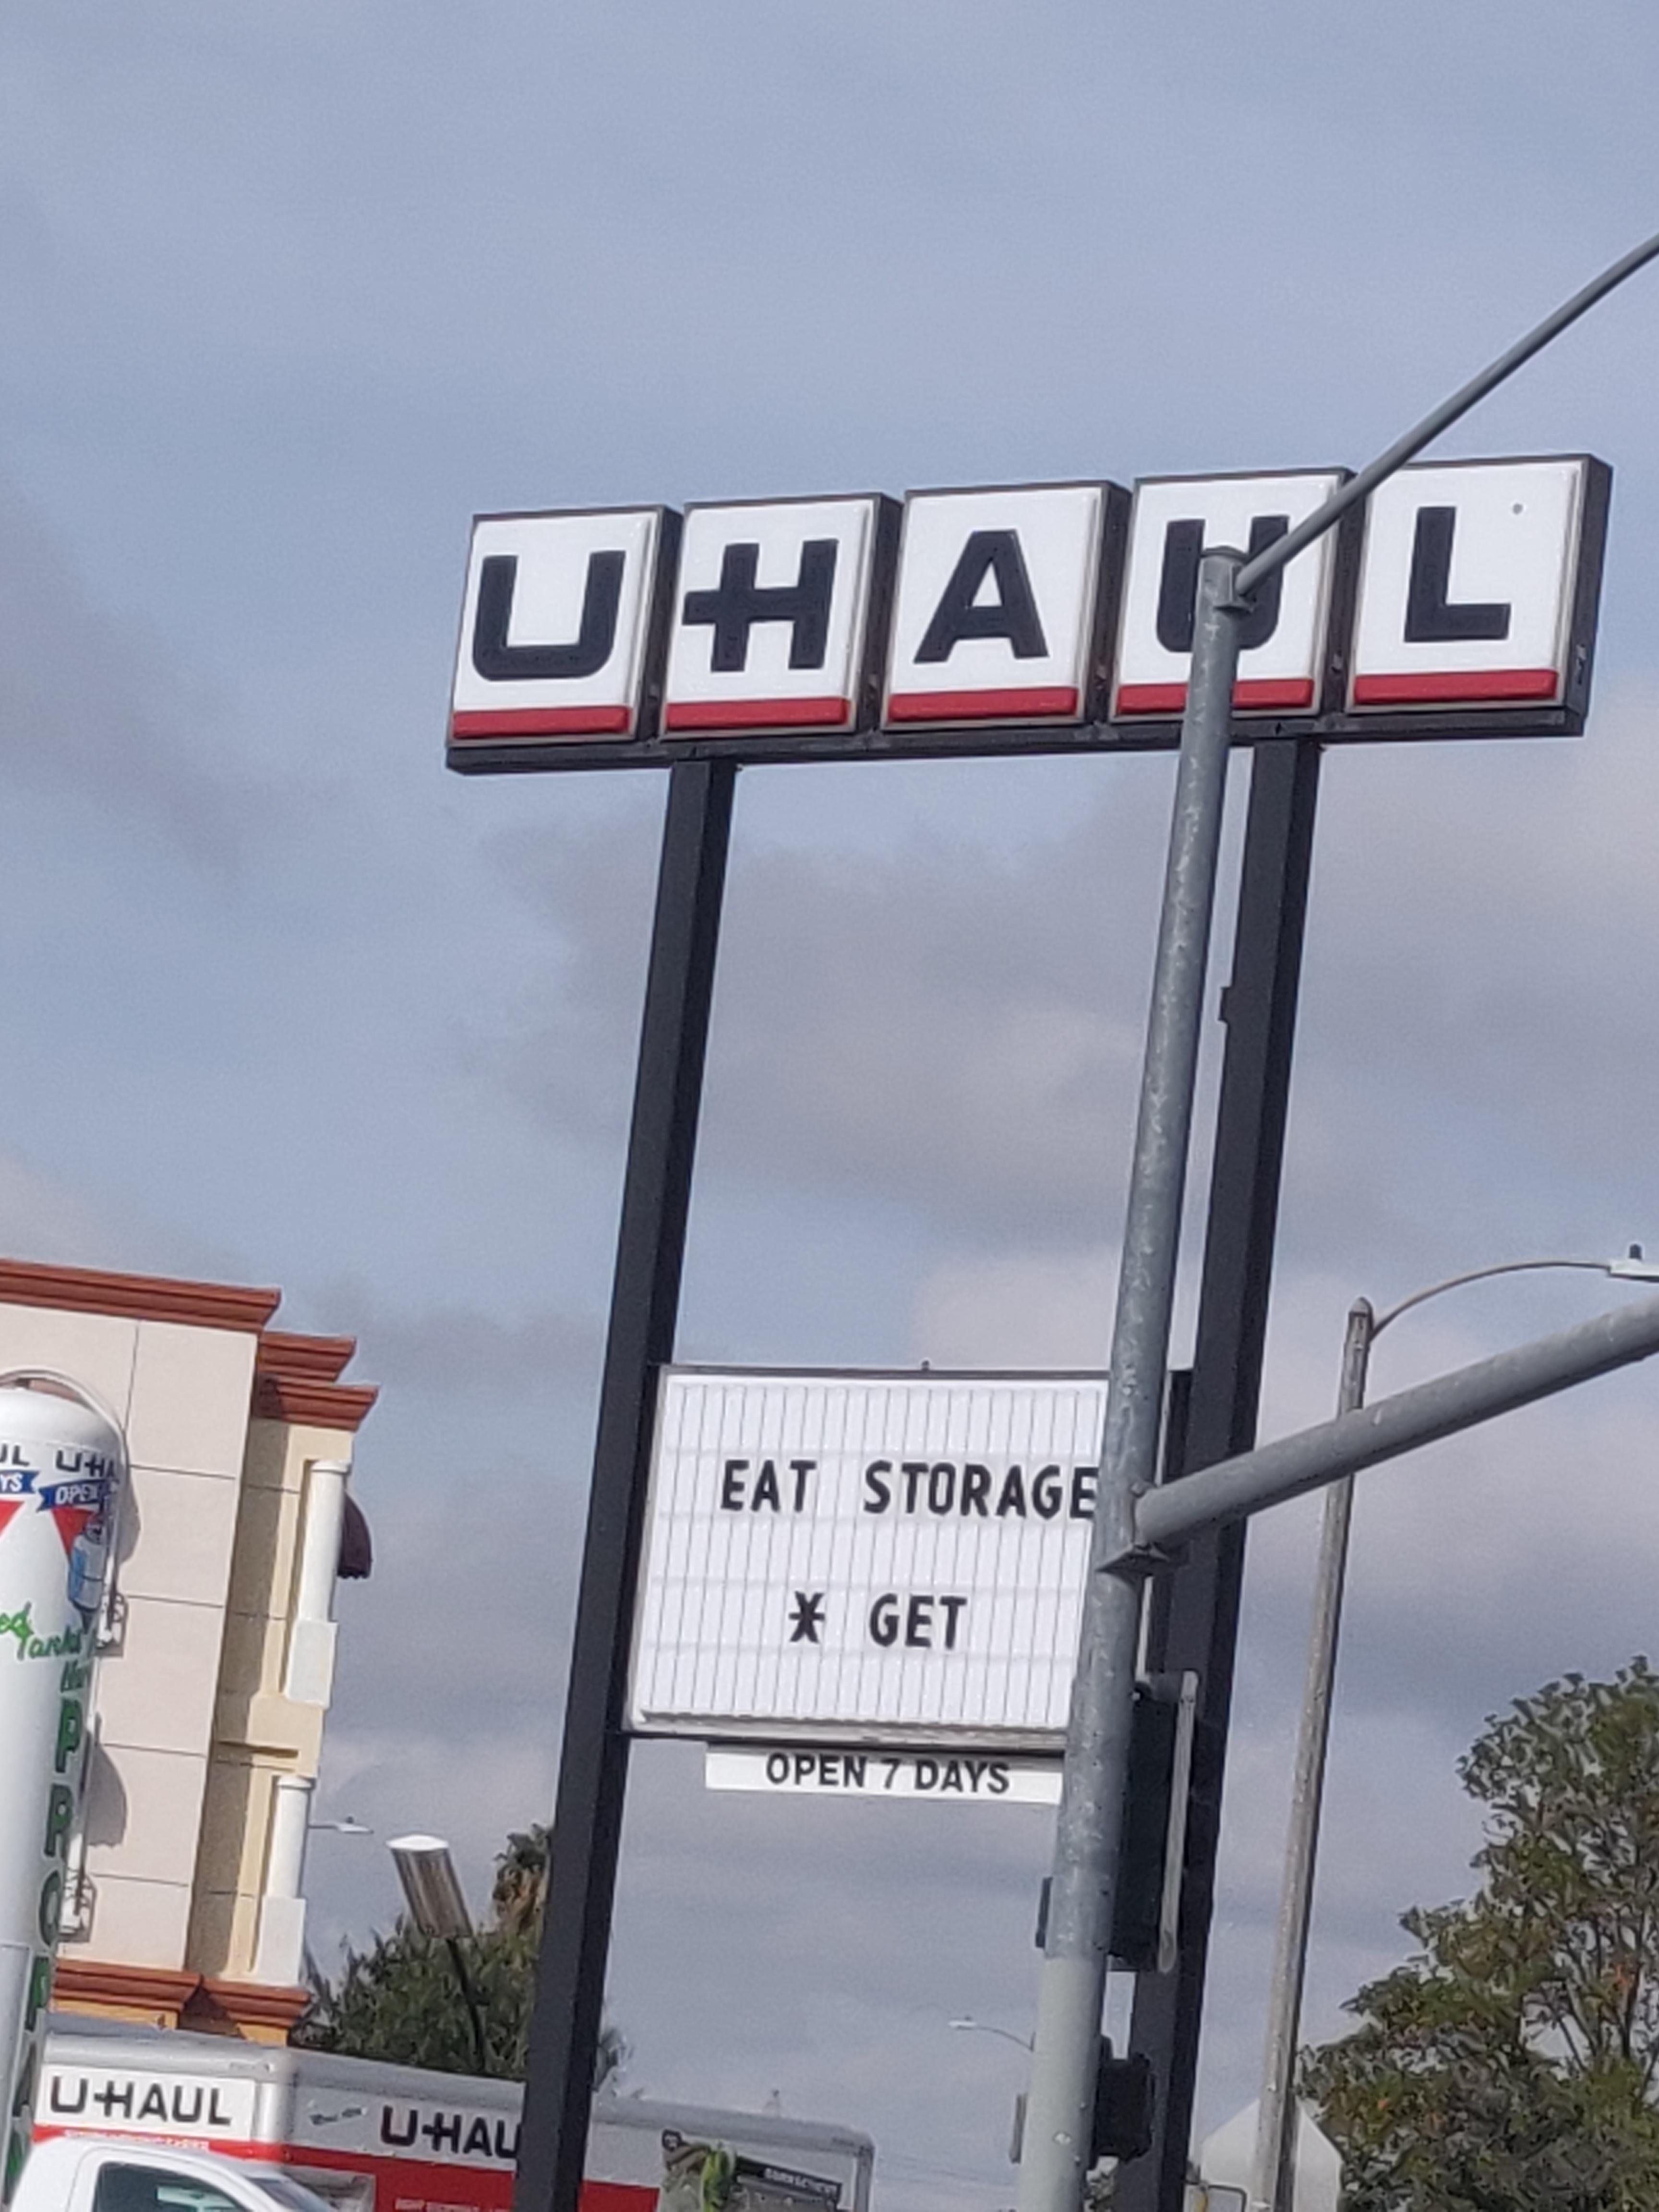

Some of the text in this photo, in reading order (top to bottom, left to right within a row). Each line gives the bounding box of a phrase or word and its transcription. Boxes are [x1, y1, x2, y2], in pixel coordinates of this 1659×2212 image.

[720, 1459, 1099, 1519] EAT STORAGE
[869, 1593, 968, 1650] GET
[766, 1752, 1010, 1794] OPEN 7 DAYS
[381, 2104, 521, 2158] U-HAU
